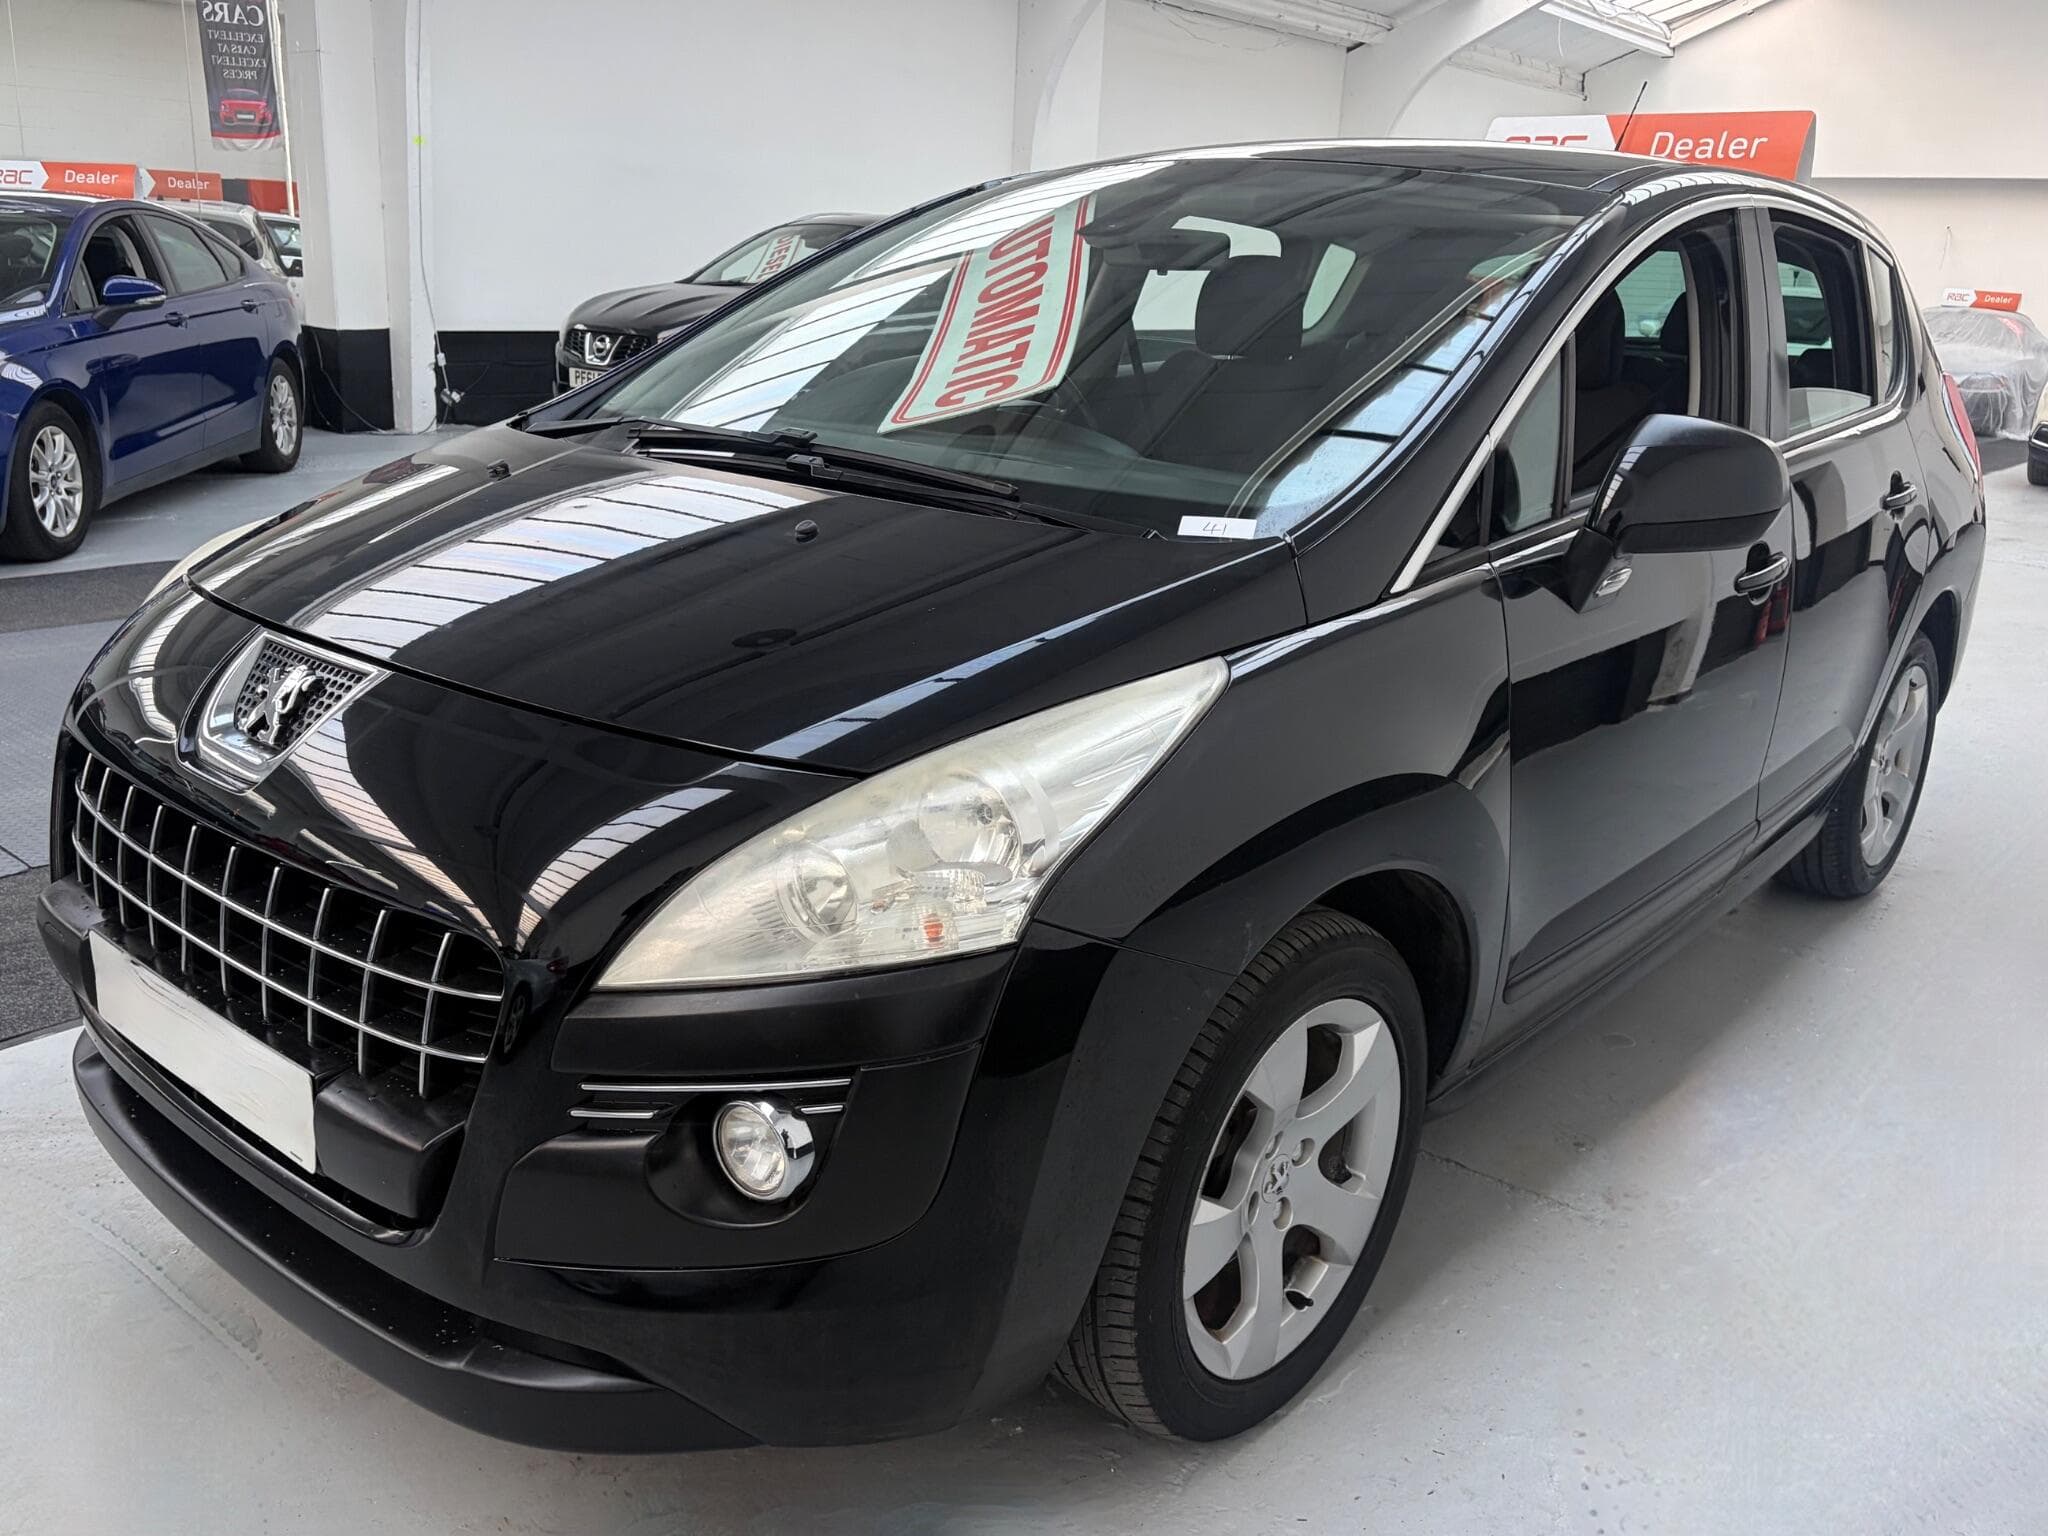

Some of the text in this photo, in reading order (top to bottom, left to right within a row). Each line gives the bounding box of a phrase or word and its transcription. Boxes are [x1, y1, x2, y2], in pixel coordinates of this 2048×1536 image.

[1650, 131, 1769, 159] Dealer
[0, 169, 119, 185] AC Dealer
[167, 176, 210, 190] Dealer
[1984, 294, 2013, 304] Dealer
[935, 215, 1055, 407] UTOMATIC
[1203, 521, 1226, 536] 41
